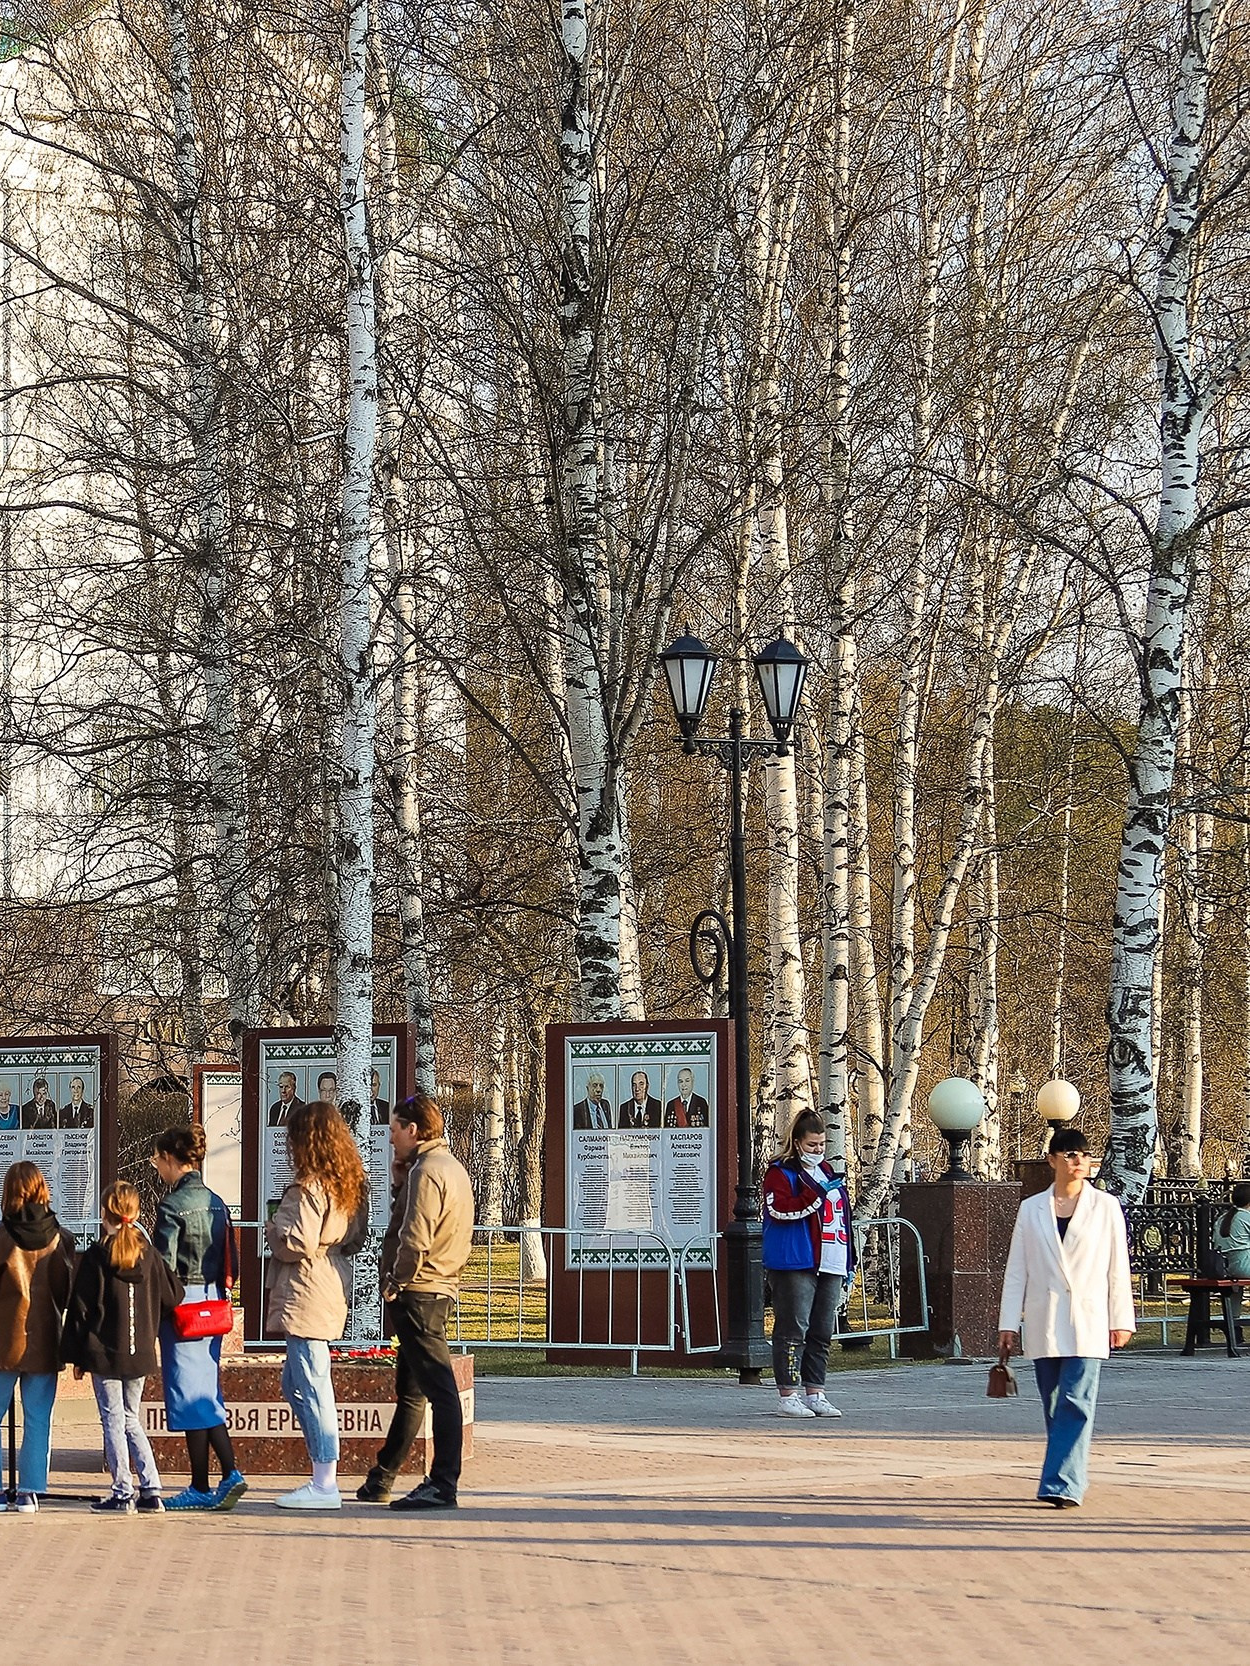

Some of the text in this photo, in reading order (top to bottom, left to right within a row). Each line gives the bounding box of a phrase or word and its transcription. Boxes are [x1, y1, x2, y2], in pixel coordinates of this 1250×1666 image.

[584, 1144, 606, 1152] Фарман
[146, 1408, 383, 1431] ПРВЬЯ ЕРЕЕВНА
